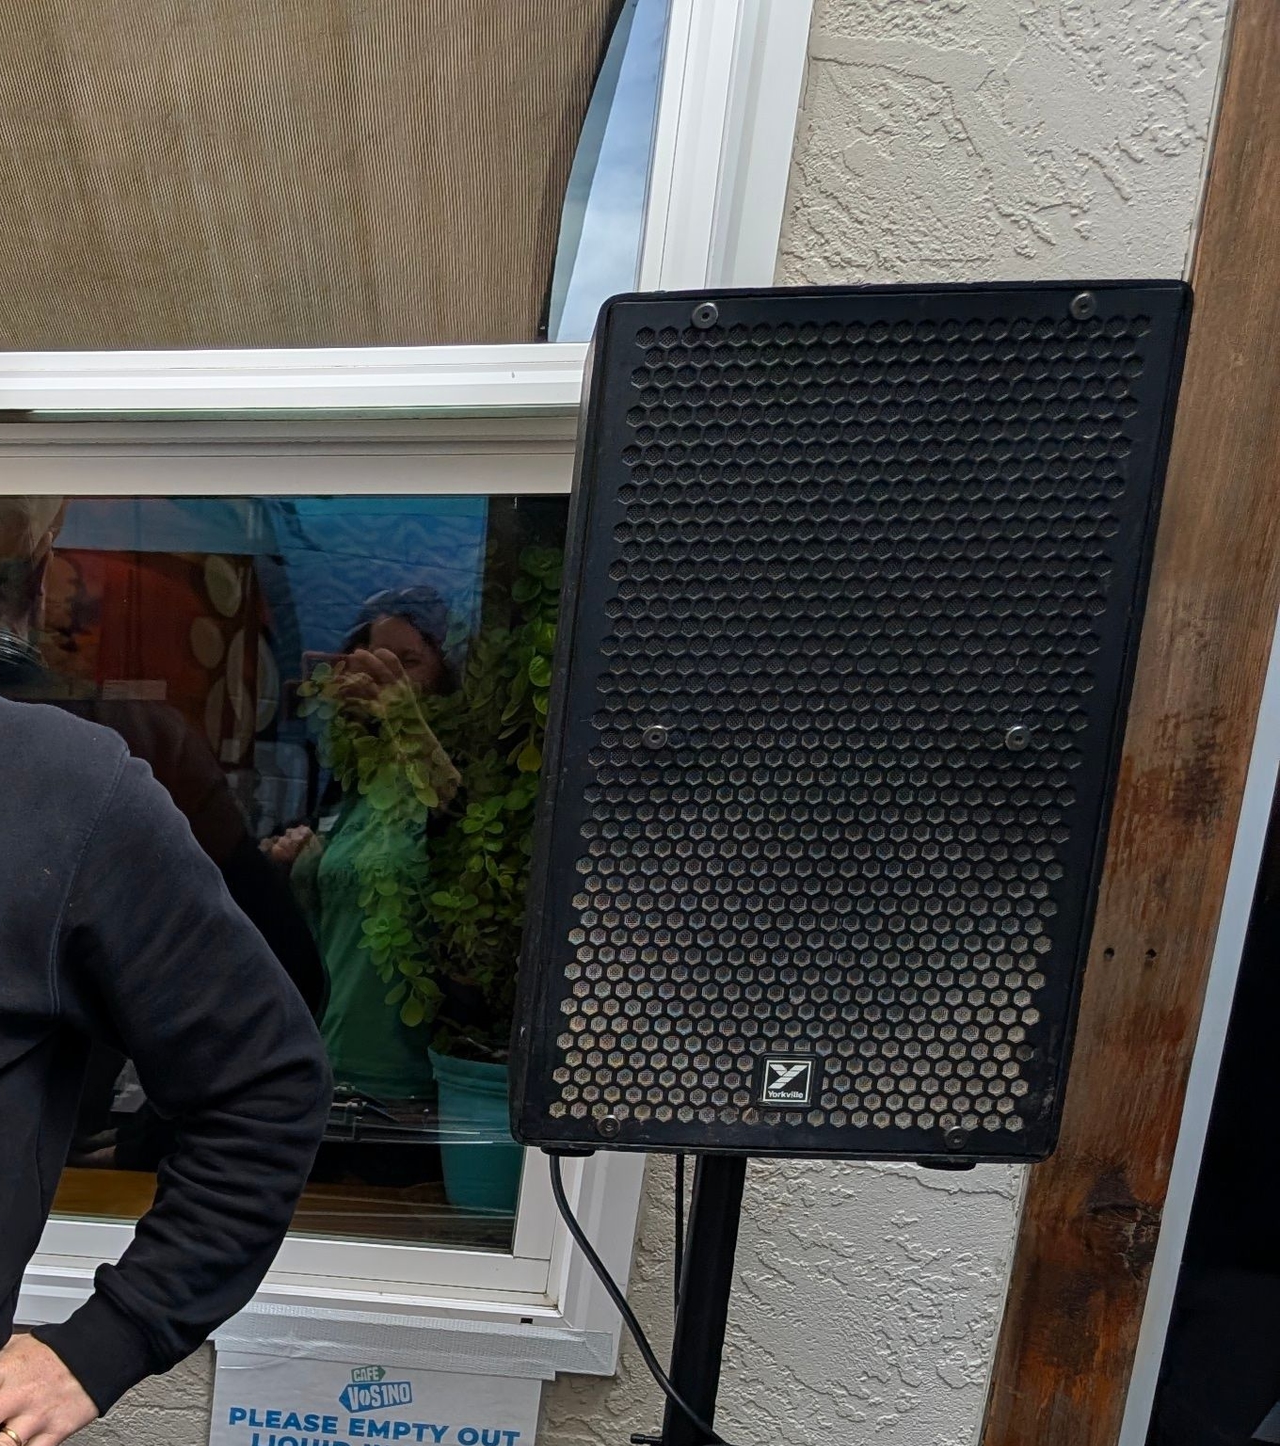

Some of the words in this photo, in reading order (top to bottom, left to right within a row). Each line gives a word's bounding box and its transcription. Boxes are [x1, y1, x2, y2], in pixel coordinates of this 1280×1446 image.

[768, 1090, 804, 1099] Yorkville
[352, 1366, 380, 1382] CAFE
[229, 1407, 338, 1435] PLEASE
[348, 1418, 449, 1444] EMPTY
